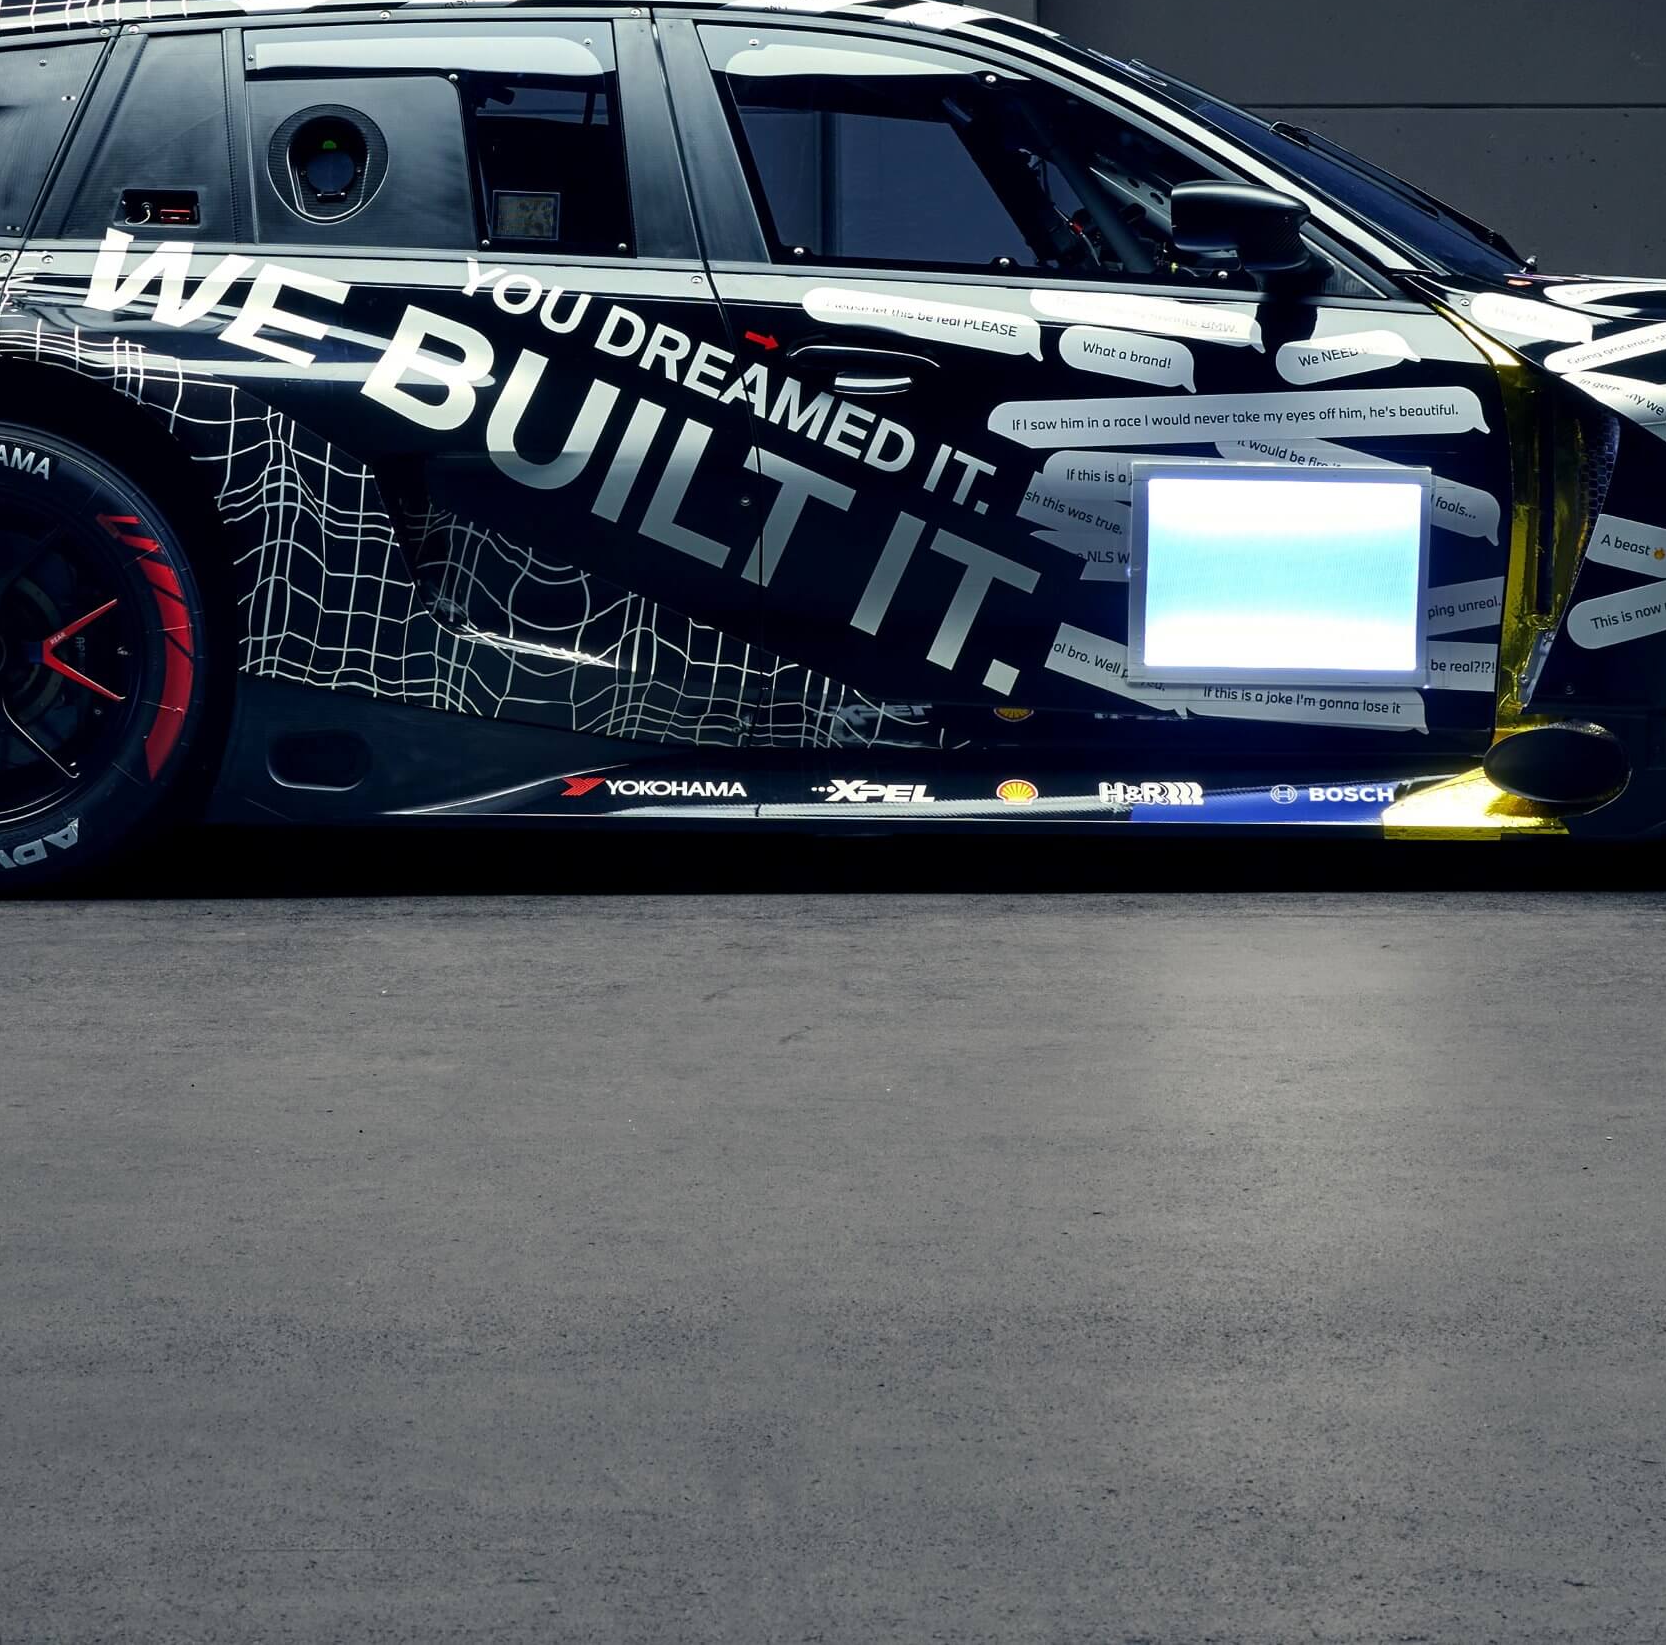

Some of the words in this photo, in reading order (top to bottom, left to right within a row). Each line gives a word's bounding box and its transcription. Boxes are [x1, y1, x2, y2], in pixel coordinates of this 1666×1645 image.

[917, 310, 934, 323] be
[936, 315, 960, 327] real
[964, 318, 1019, 338] PLEASE
[1083, 341, 1117, 359] What
[1119, 350, 1127, 360] a
[1130, 352, 1172, 370] brand!
[1298, 355, 1320, 367] We
[461, 257, 592, 334] YOU
[593, 305, 916, 473] DREAMED
[923, 444, 998, 515] IT.
[1012, 419, 1021, 431] If
[1030, 421, 1057, 431] saw
[1061, 417, 1084, 430] him
[1087, 417, 1099, 429] in
[1102, 419, 1111, 427] a
[1114, 418, 1142, 428] race
[1151, 413, 1191, 426] would
[1194, 414, 1230, 425] never
[1232, 411, 1260, 423] take
[1263, 412, 1283, 424] my
[1286, 411, 1316, 423] eyes
[1319, 408, 1336, 420] off
[1339, 407, 1367, 421] him,
[1369, 405, 1397, 419] he's
[1399, 403, 1460, 418] beautiful.
[1646, 399, 1665, 416] we
[82, 226, 351, 369] WE
[360, 304, 857, 588] BUILT
[849, 511, 1041, 697] IT.
[1248, 439, 1288, 460] would
[1289, 449, 1306, 465] be
[1066, 468, 1075, 481] If
[1078, 469, 1101, 482] this
[1104, 470, 1115, 483] is
[1118, 473, 1126, 483] a
[1042, 495, 1066, 514] this
[1068, 506, 1094, 524] was
[1095, 516, 1123, 535] true.
[1435, 496, 1477, 520] fools...
[1087, 550, 1115, 564] NLS
[1600, 534, 1612, 547] A
[1614, 536, 1651, 556] beast
[1458, 595, 1502, 614] unreal.
[1590, 614, 1620, 630] This
[1621, 611, 1633, 623] is
[1635, 604, 1662, 619] now
[1067, 645, 1091, 664] bro.
[1094, 655, 1121, 675] Well
[1431, 658, 1447, 672] be
[1203, 686, 1213, 698] If
[1215, 687, 1238, 701] this
[1241, 689, 1252, 702] is
[1255, 693, 1263, 703] a
[1265, 691, 1293, 706] joke
[1296, 693, 1316, 707] I'm
[1319, 698, 1359, 711] gonna
[1362, 698, 1389, 714] lose
[1392, 701, 1401, 715] it
[605, 779, 748, 798] YOKOHAMA
[824, 779, 935, 802] XPEL
[1098, 781, 1171, 805] H&R
[1308, 786, 1395, 803] BOSCH
